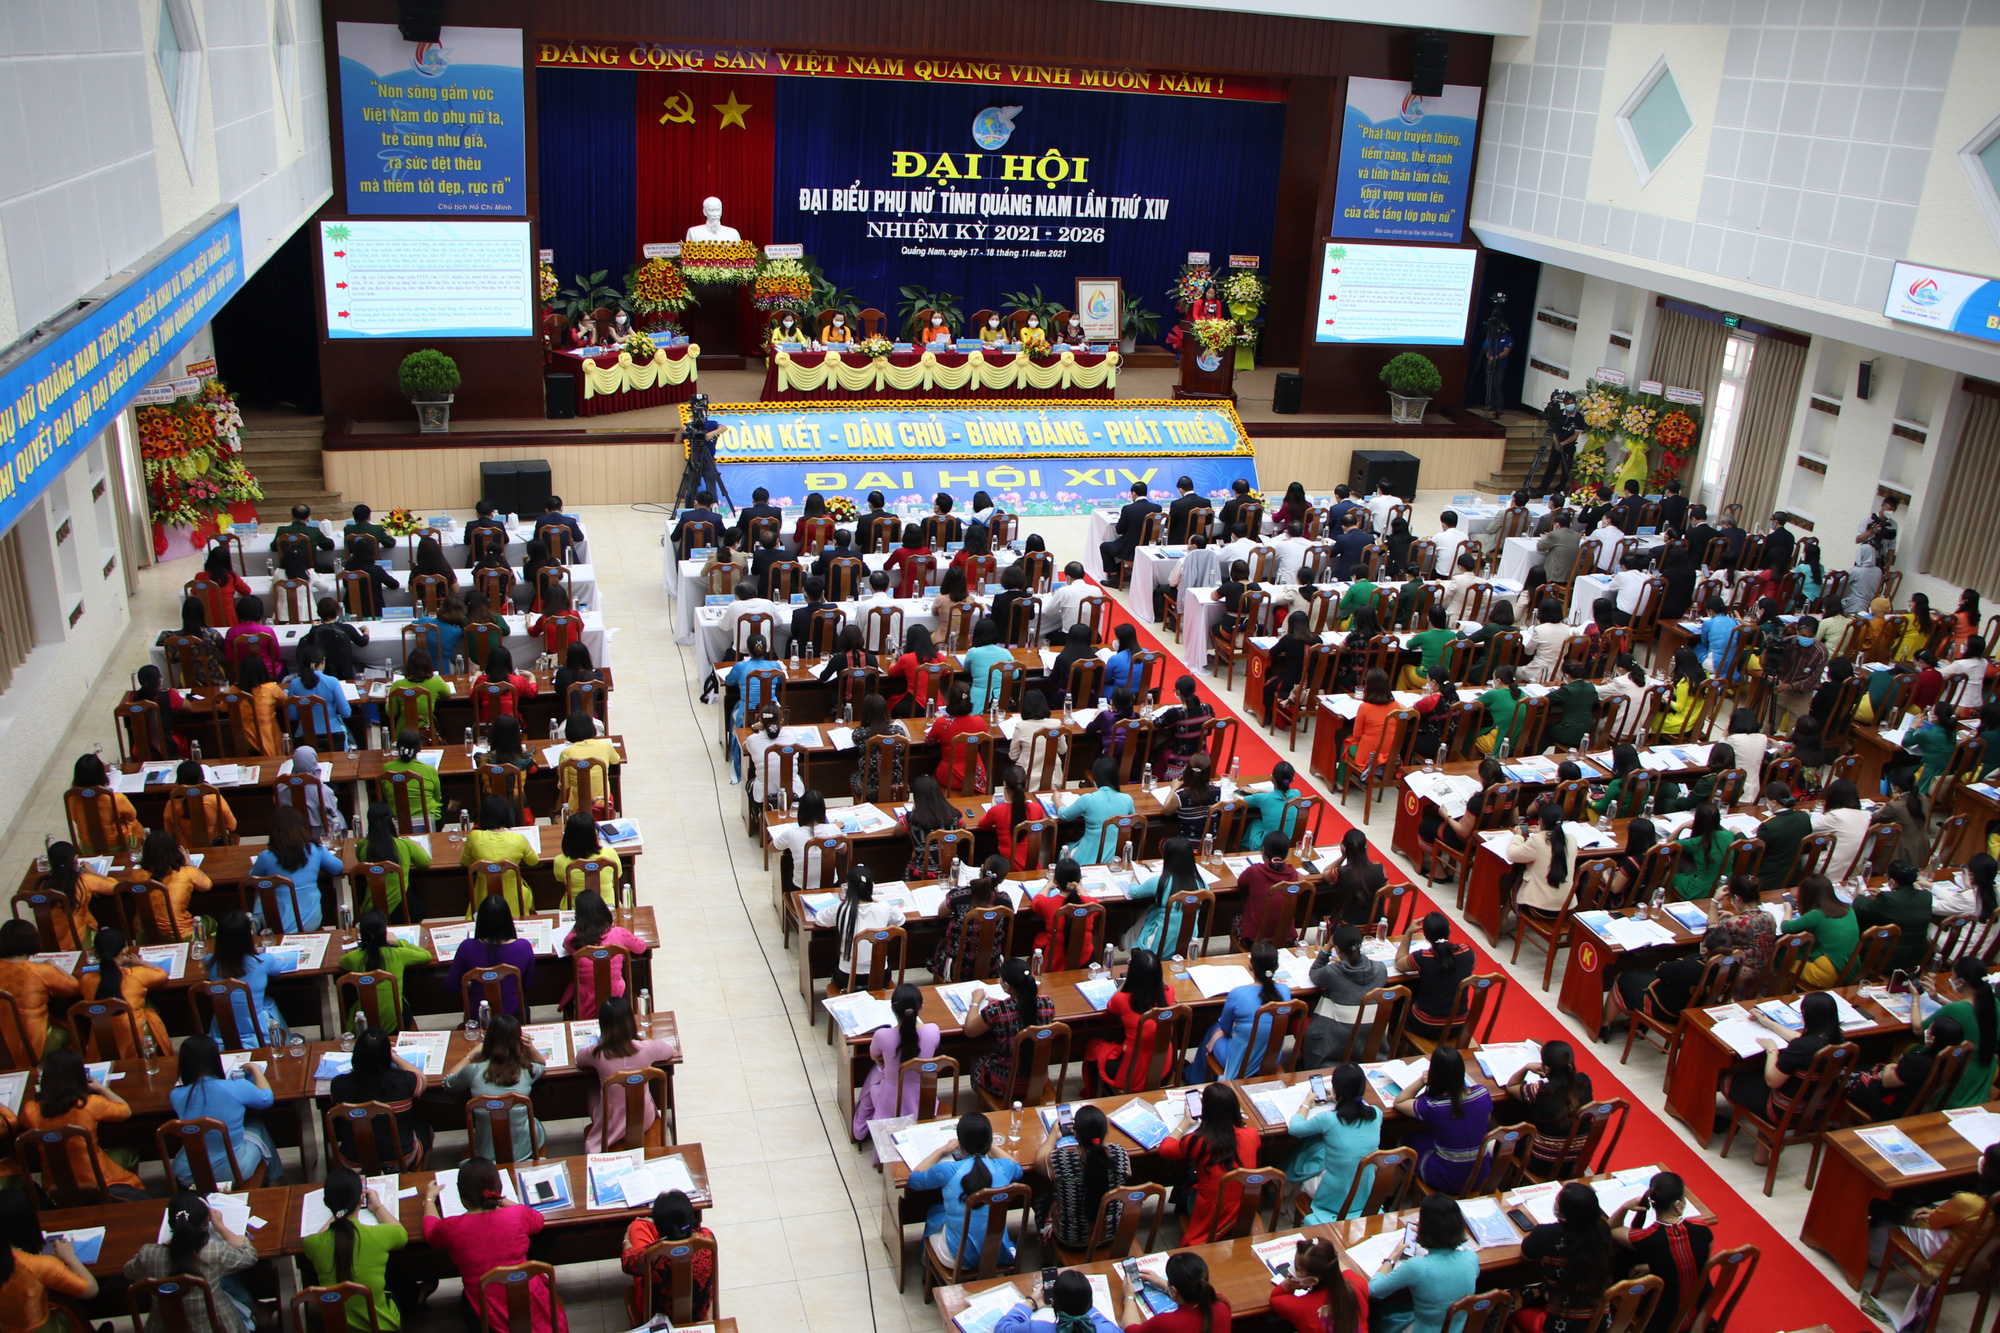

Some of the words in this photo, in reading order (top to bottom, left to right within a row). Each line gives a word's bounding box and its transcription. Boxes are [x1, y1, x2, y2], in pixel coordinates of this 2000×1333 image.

[540, 39, 619, 65] ĐẢNG
[629, 43, 703, 70] CỘNG
[714, 45, 768, 70] SẢN
[776, 50, 839, 76] VIỆT
[846, 56, 905, 77] NAM
[914, 59, 1001, 81] QUANG
[1007, 64, 1071, 85] VINH
[1079, 66, 1151, 90] MUÔN
[1158, 69, 1212, 94] NĂM
[407, 85, 437, 101] sông
[441, 83, 468, 101] gấm
[472, 87, 494, 100] vóc
[362, 107, 387, 124] Việt
[390, 109, 420, 122] Nam
[424, 109, 439, 123] do
[443, 110, 465, 125] phụ
[469, 111, 485, 124] nữ
[488, 112, 504, 126] ta,
[382, 130, 399, 146] trẻ
[403, 133, 433, 148] cũng
[437, 134, 460, 147] như
[464, 134, 487, 149] già,
[1385, 128, 1401, 142] huy
[1404, 129, 1432, 144] truyền
[1434, 131, 1461, 147] thống,
[389, 158, 402, 170] ra
[406, 156, 428, 170] sức
[432, 157, 451, 173] dệt
[454, 158, 481, 171] thêu
[1361, 146, 1382, 160] tiềm
[1411, 149, 1427, 162] thế
[1428, 153, 1453, 167] mạnh
[891, 150, 983, 186] ĐẠI
[1000, 148, 1090, 189] HỘI
[1358, 168, 1369, 179] và
[1371, 168, 1389, 180] tinh
[1390, 168, 1410, 181] thần
[1413, 170, 1430, 183] làm
[360, 179, 380, 193] mà
[384, 179, 414, 193] thêm
[418, 178, 435, 193] tốt
[438, 180, 465, 197] đẹp,
[468, 181, 488, 197] rực
[1360, 187, 1381, 199] khát
[1383, 190, 1404, 203] vọng
[1430, 191, 1444, 203] lên
[799, 187, 828, 216] ĐẠI
[832, 179, 869, 213] BIỂU
[874, 190, 906, 218] PHỤ
[911, 188, 935, 214] NỮ
[941, 185, 975, 216] TỈNH
[980, 186, 1032, 218] QUẢNG
[1035, 195, 1072, 218] NAM
[1076, 189, 1106, 219] LẦN
[1110, 193, 1142, 220] THỨ
[1144, 199, 1170, 221] XIV
[1344, 205, 1361, 218] của
[1363, 208, 1380, 219] các
[1382, 206, 1402, 222] tầng
[1404, 208, 1418, 223] lớp
[1420, 211, 1438, 225] phụ
[866, 218, 949, 243] NHIỆM
[955, 220, 989, 240] KỲ
[994, 225, 1040, 242] 2021
[1058, 227, 1106, 244] 2026
[901, 246, 926, 257] Quảng
[927, 247, 947, 257] Nam,
[948, 248, 968, 258] ngày
[969, 248, 979, 256] 17
[986, 248, 995, 256] 18
[996, 248, 1019, 259] tháng
[1021, 249, 1028, 257] 11
[1029, 249, 1046, 257] năm
[1047, 250, 1067, 258] 2021
[0, 405, 17, 447] HỤ
[16, 384, 36, 429] NỮ
[37, 361, 75, 413] QUẢNG
[74, 340, 99, 381] NAM
[99, 323, 119, 360] TÍCH
[119, 310, 136, 344] CỰC
[135, 288, 157, 329] TRIỂN
[155, 281, 173, 312] KHAI
[0, 461, 16, 501] HỊ
[15, 421, 54, 484] QUYẾT
[53, 406, 74, 448] ĐẠI
[73, 390, 92, 428] HỘI
[92, 376, 109, 411] ĐẠI
[108, 352, 129, 396] BIỂU
[127, 341, 150, 377] ĐẢNG
[148, 326, 160, 357] BỘ
[193, 286, 208, 314] NAM
[777, 416, 822, 449] KẾT
[845, 419, 897, 449] DÂN
[903, 414, 947, 449] CHỦ
[969, 419, 1029, 447] BÌNH
[1030, 410, 1088, 446] ĐẲNG
[1107, 412, 1159, 446] PHÁT
[1163, 411, 1229, 446] TRIỂN
[940, 465, 1041, 492] HỘI
[1063, 467, 1160, 488] XIV
[1254, 661, 1260, 673] E
[1582, 947, 1593, 966] K
